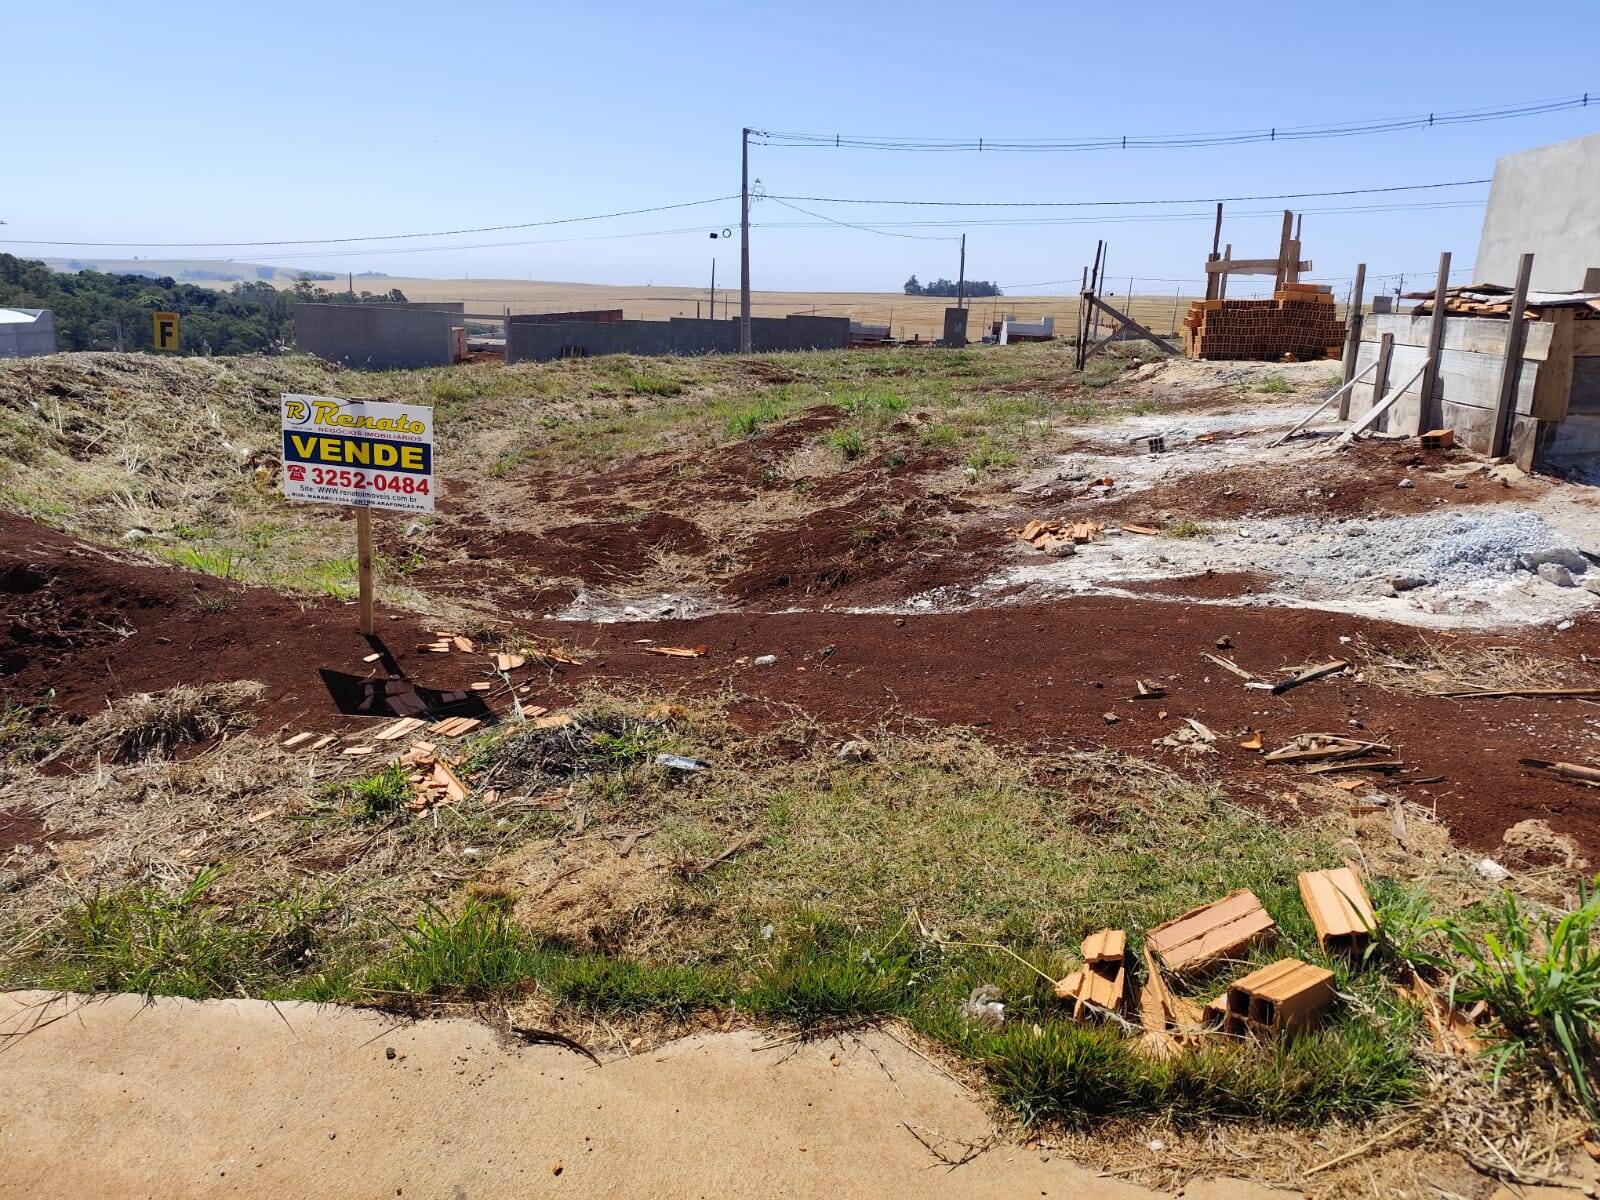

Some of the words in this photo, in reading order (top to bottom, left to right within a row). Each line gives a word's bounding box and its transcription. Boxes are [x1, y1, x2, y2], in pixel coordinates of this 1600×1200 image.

[160, 321, 173, 347] F
[285, 401, 305, 419] R
[311, 400, 426, 434] Renato
[291, 435, 424, 470] VENDE
[311, 467, 430, 496] 3252-0484
